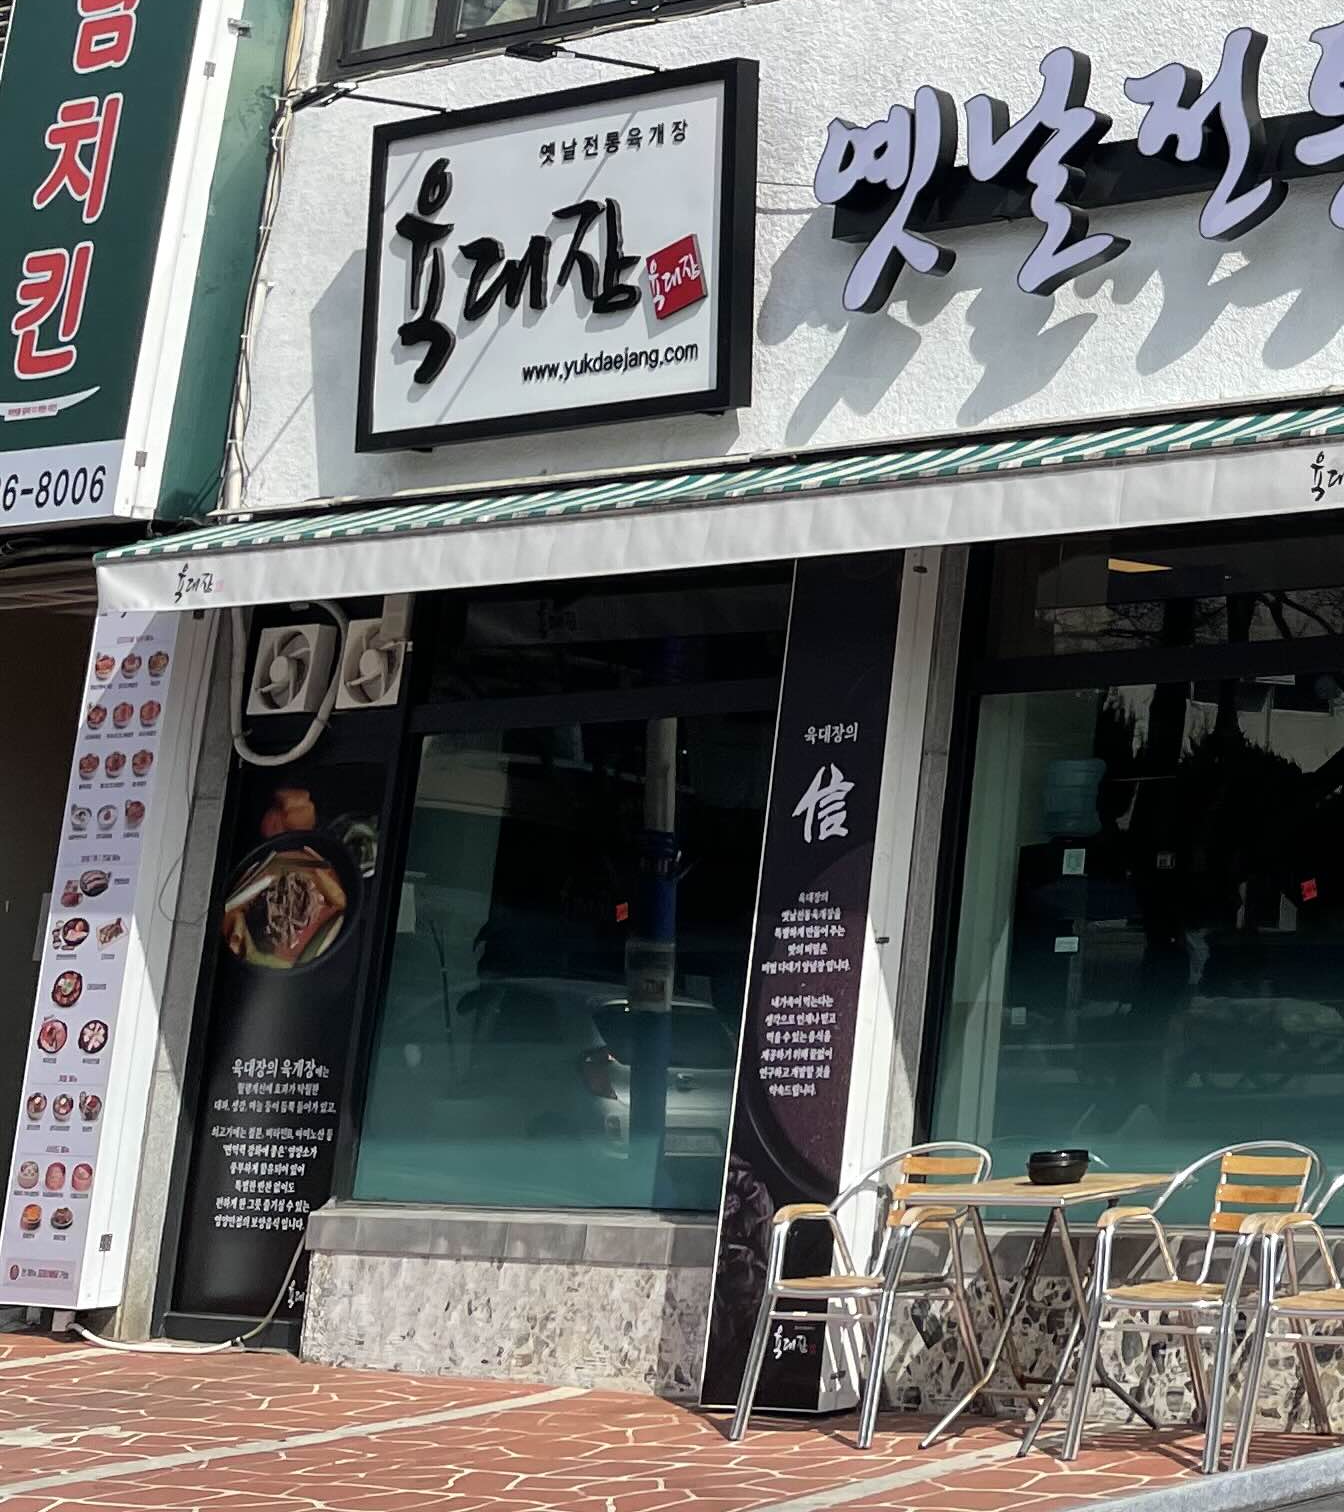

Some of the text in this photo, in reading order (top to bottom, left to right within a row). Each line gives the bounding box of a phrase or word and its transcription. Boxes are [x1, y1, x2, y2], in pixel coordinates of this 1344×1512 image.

[538, 118, 689, 168] 옛날전통육개장
[395, 157, 642, 384] 육대장
[522, 341, 699, 384] www.yukdaejang.com
[0, 464, 107, 512] 6-8006
[174, 563, 213, 604] 육대장
[804, 721, 858, 744] 육대장의
[791, 762, 855, 843] 信
[232, 1058, 278, 1078] 육대장의
